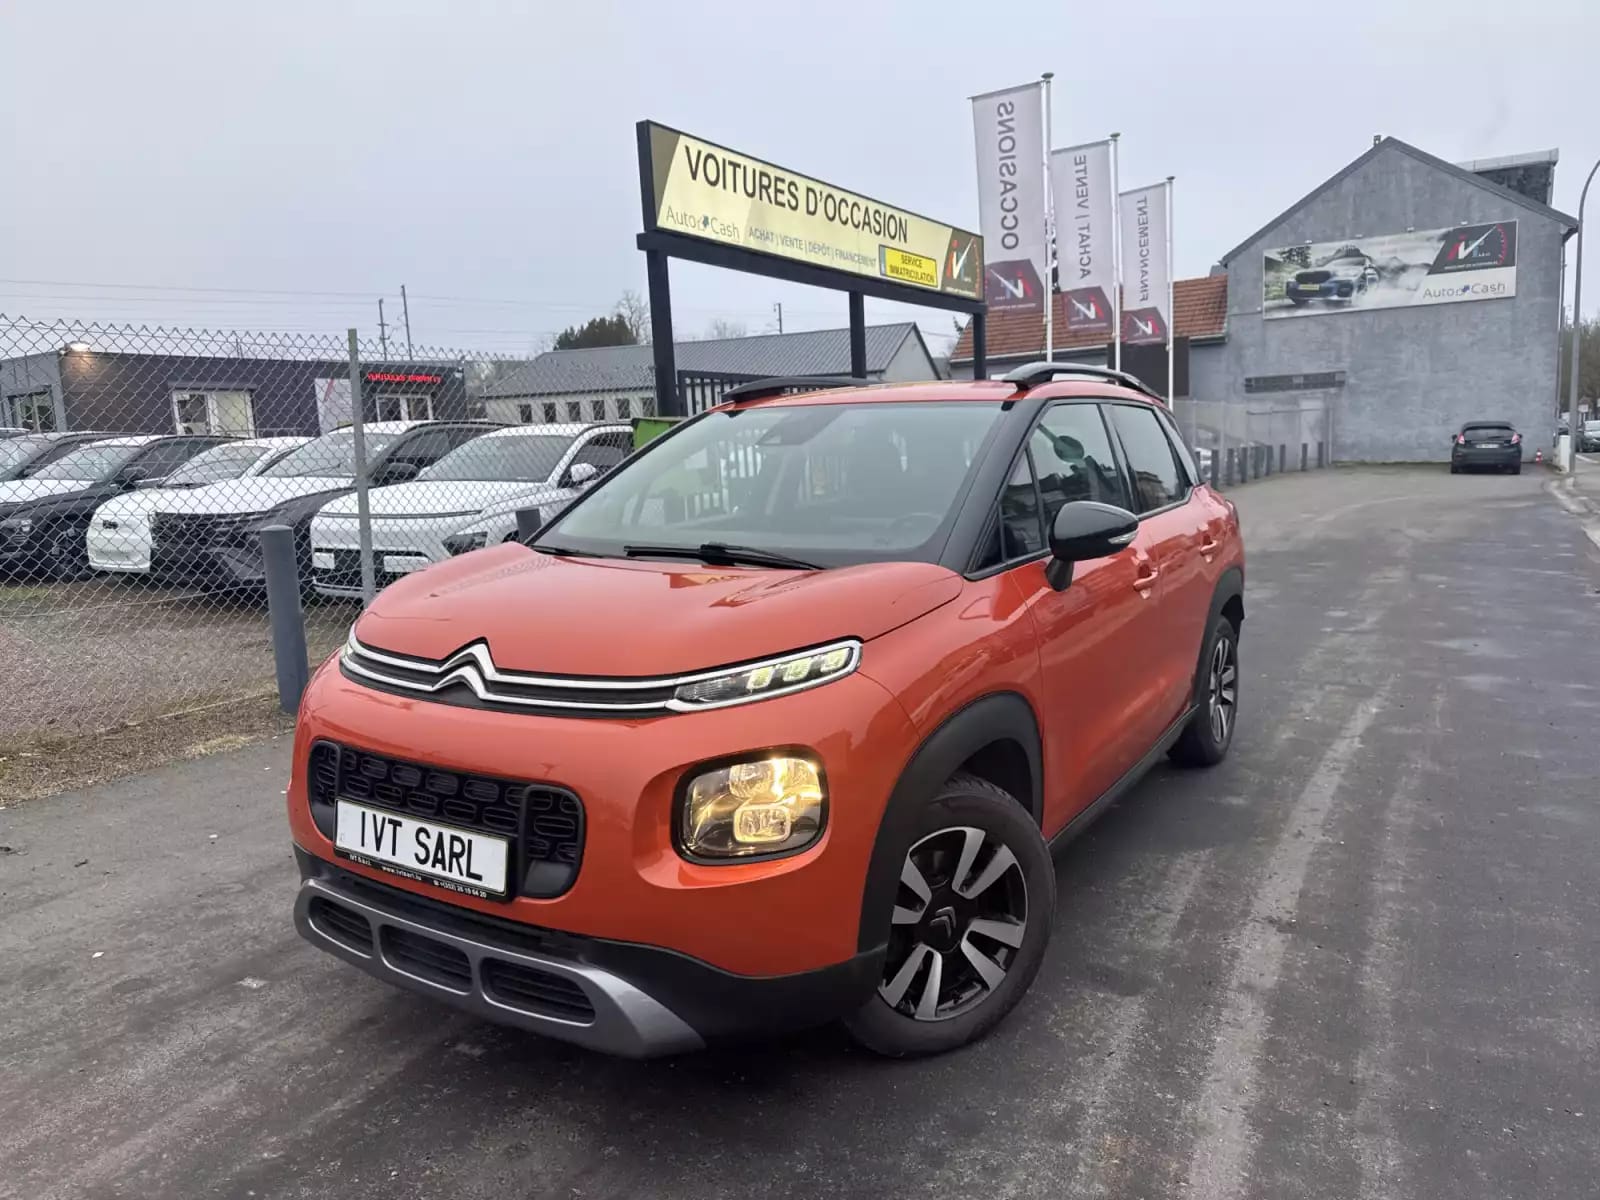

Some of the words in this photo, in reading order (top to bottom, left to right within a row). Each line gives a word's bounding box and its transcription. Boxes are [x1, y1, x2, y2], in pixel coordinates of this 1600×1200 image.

[684, 145, 799, 212] VOITURES
[805, 183, 908, 244] D'OCCASION
[710, 217, 740, 241] Cash
[749, 226, 775, 244] ACHAT
[780, 232, 804, 250] VENTE
[834, 247, 877, 269] FINANCEMENT
[900, 254, 923, 268] SERVICE
[1471, 283, 1506, 295] Cash
[361, 811, 402, 857] IVT
[414, 826, 483, 881] SARL
